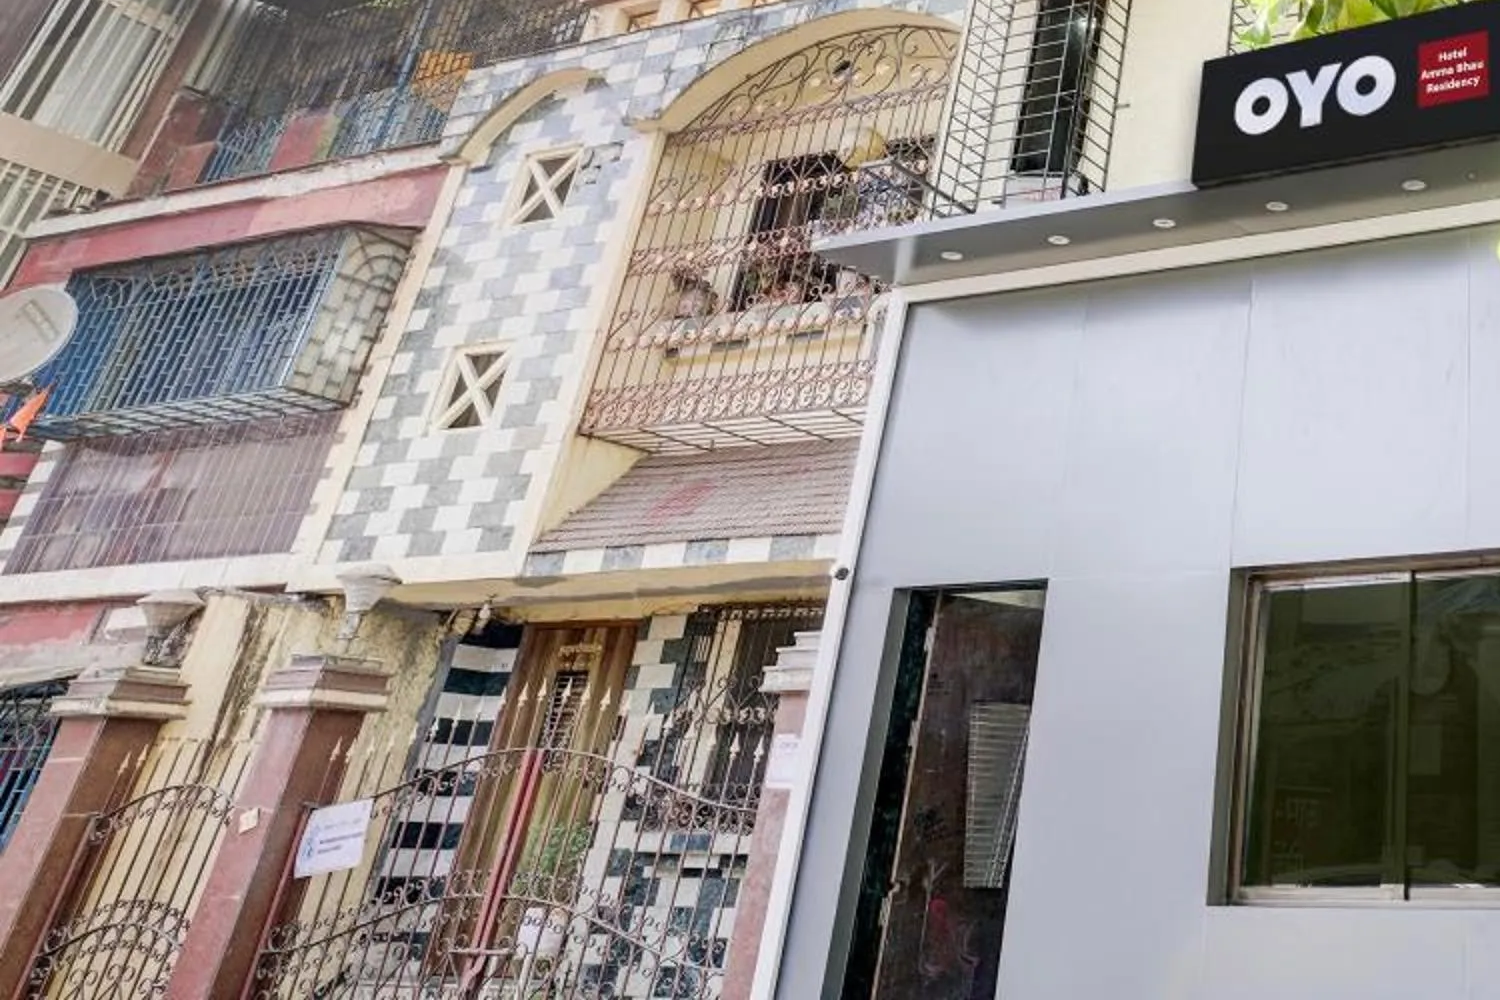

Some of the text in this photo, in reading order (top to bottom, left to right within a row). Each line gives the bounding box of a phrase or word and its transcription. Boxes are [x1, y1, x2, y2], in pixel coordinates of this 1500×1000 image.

[1438, 46, 1468, 62] Hotel
[1426, 75, 1481, 94] Residency
[1234, 55, 1396, 134] OYO
